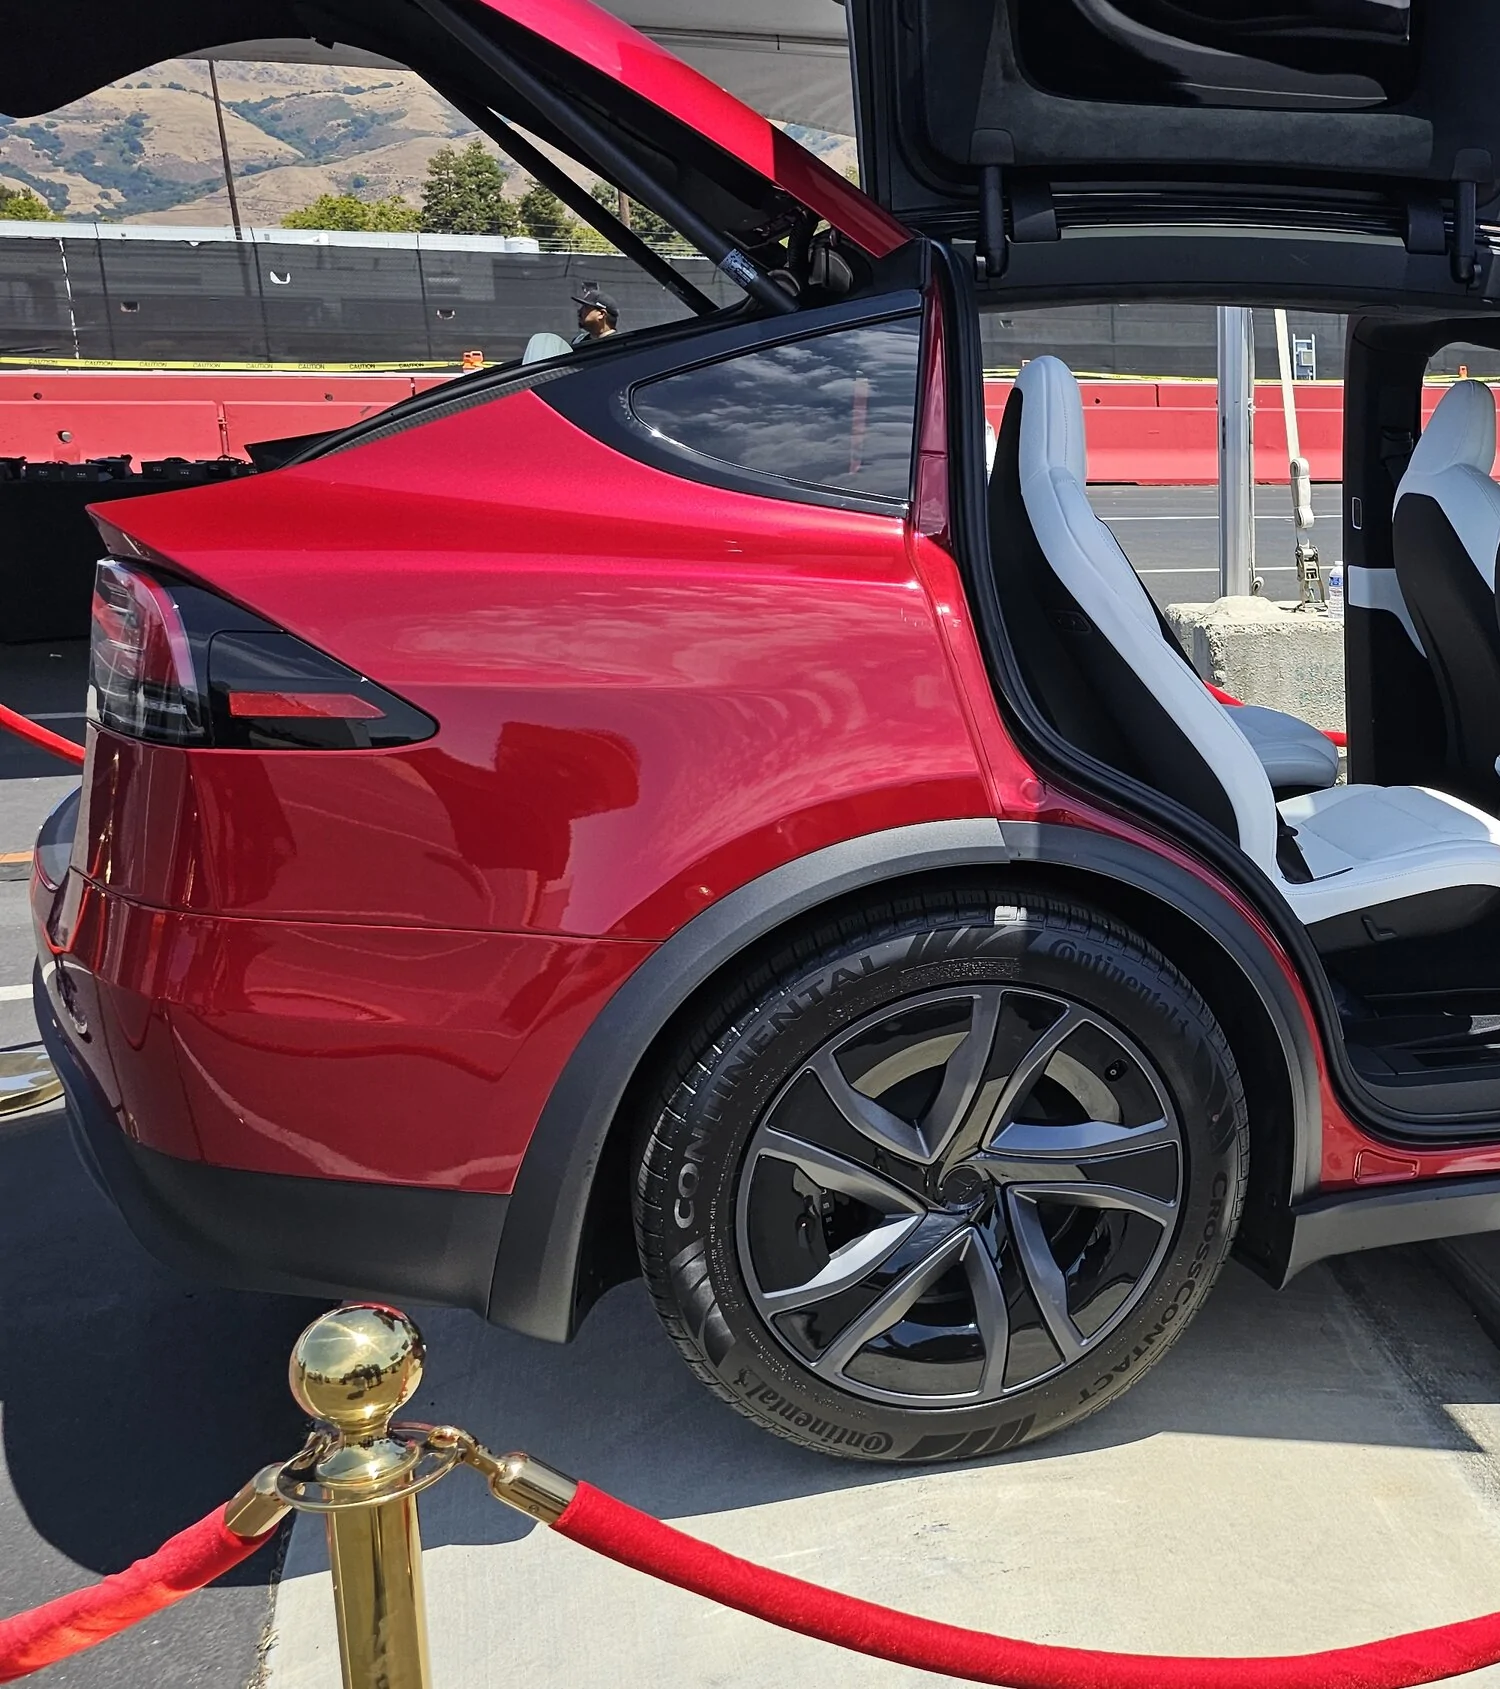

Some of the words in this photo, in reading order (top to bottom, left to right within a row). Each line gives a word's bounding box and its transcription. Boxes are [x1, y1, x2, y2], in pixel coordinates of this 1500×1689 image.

[1049, 938, 1179, 1021] Continental
[674, 955, 890, 1229] CONTINENTAL
[744, 1381, 894, 1454] Continental
